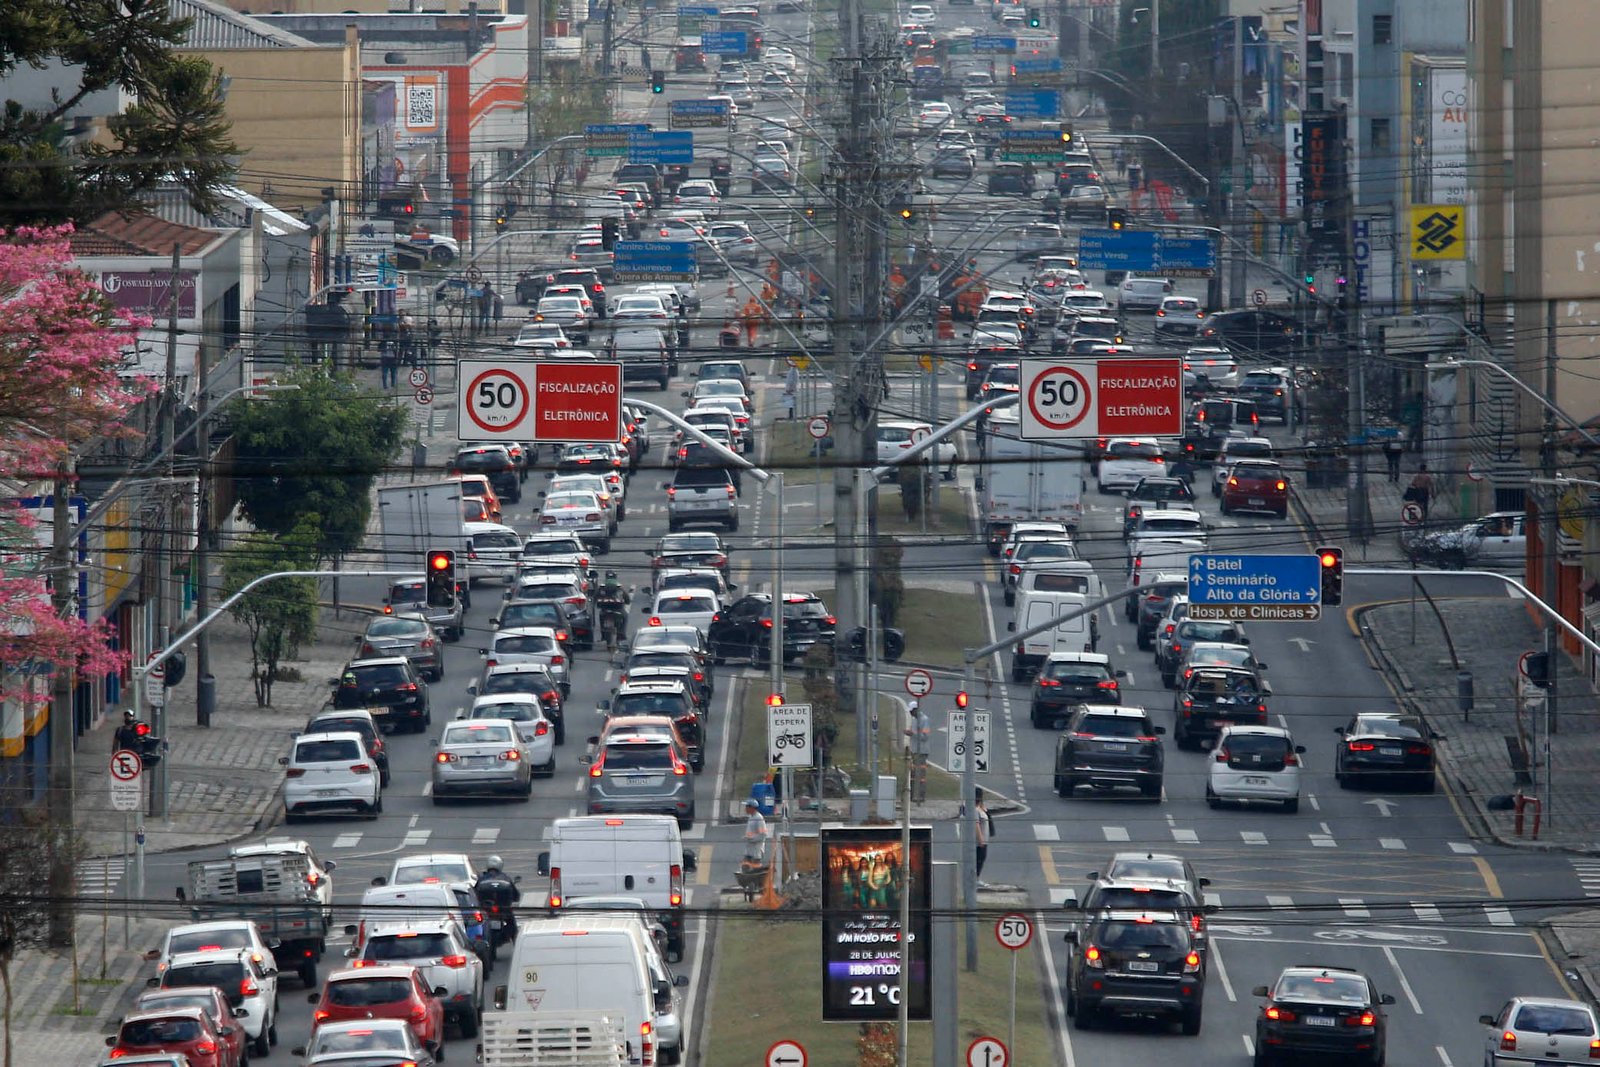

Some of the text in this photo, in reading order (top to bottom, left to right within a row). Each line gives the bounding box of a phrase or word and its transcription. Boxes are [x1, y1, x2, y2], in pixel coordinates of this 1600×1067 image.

[1104, 252, 1129, 260] Verde
[1352, 220, 1370, 304] HOTE
[122, 279, 152, 288] OSWALD
[412, 372, 425, 382] 50
[1100, 375, 1177, 391] FISCALIZAÇÃO
[539, 381, 616, 396] FISCALIZAÇÃO
[1041, 380, 1079, 407] 50
[479, 382, 517, 409] 50
[544, 408, 610, 422] ELETRÔNICA
[1106, 403, 1172, 417] ELETRÔNICA
[1206, 558, 1242, 571] Batel
[1207, 573, 1277, 586] Seminário
[1206, 588, 1301, 600] Alto da Glória
[1190, 605, 1305, 620] Hosp. de Clínicas
[797, 707, 807, 715] DE
[953, 711, 987, 723] ÁR DE
[774, 718, 806, 726] ESPERA
[954, 725, 985, 733] ESRA
[1002, 920, 1027, 937] 50
[838, 932, 853, 943] UM
[853, 932, 880, 943] NOVO
[850, 951, 902, 960] 28 DE JULHO
[526, 972, 539, 983] 90
[849, 983, 901, 1006] 21 °C
